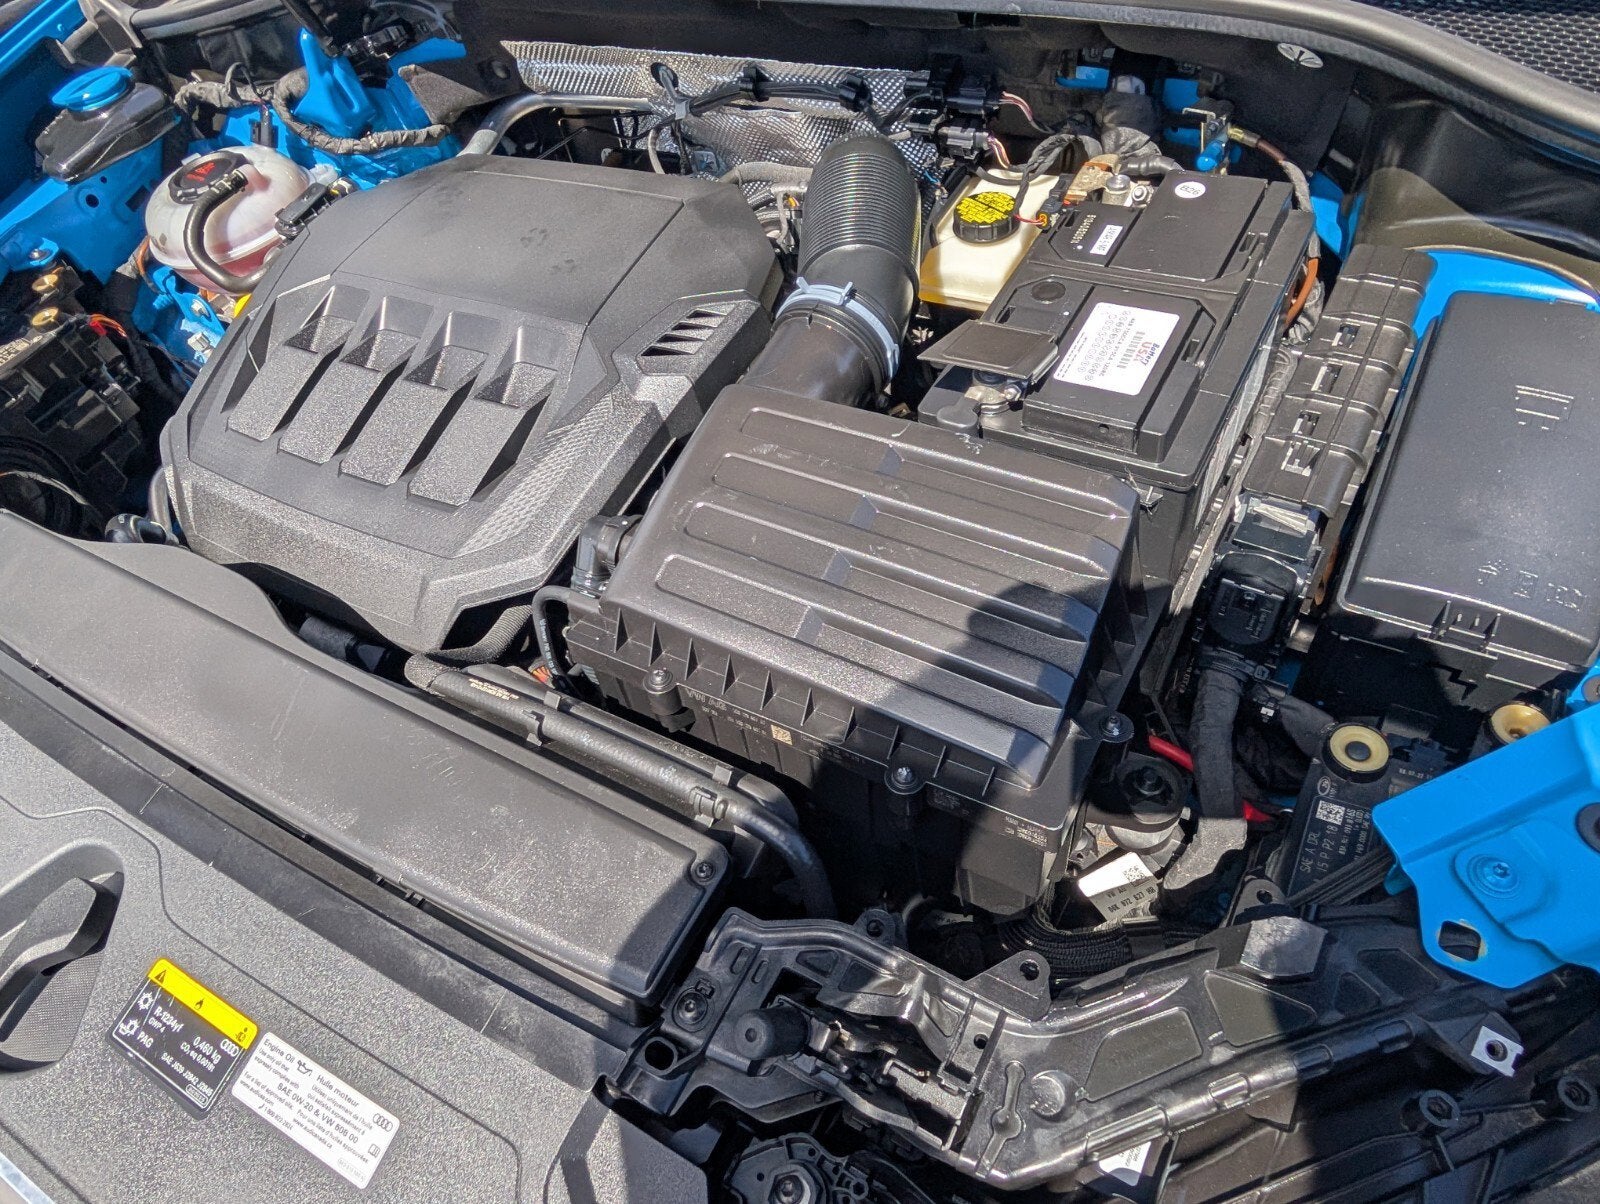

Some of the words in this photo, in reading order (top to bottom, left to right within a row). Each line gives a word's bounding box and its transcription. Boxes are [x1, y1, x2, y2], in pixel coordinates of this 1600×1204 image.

[1133, 341, 1151, 362] USA
[1141, 343, 1159, 365] Battery
[1299, 857, 1313, 873] SAE
[1306, 831, 1320, 845] DRL
[1321, 838, 1334, 850] P2
[1319, 851, 1329, 859] P
[148, 1017, 161, 1028] GWP
[154, 1006, 183, 1031] R-1234yf
[137, 1031, 153, 1047] PAG
[161, 1052, 173, 1064] SAE
[210, 1049, 221, 1064] kg
[263, 1038, 284, 1056] Engine
[285, 1053, 295, 1063] Oil
[316, 1074, 333, 1090] Huile
[333, 1088, 358, 1106] moteur
[277, 1082, 292, 1096] SAE
[291, 1093, 313, 1111] 0W-20
[313, 1108, 319, 1117] &
[321, 1113, 335, 1126] VW
[348, 1133, 358, 1143] 00
